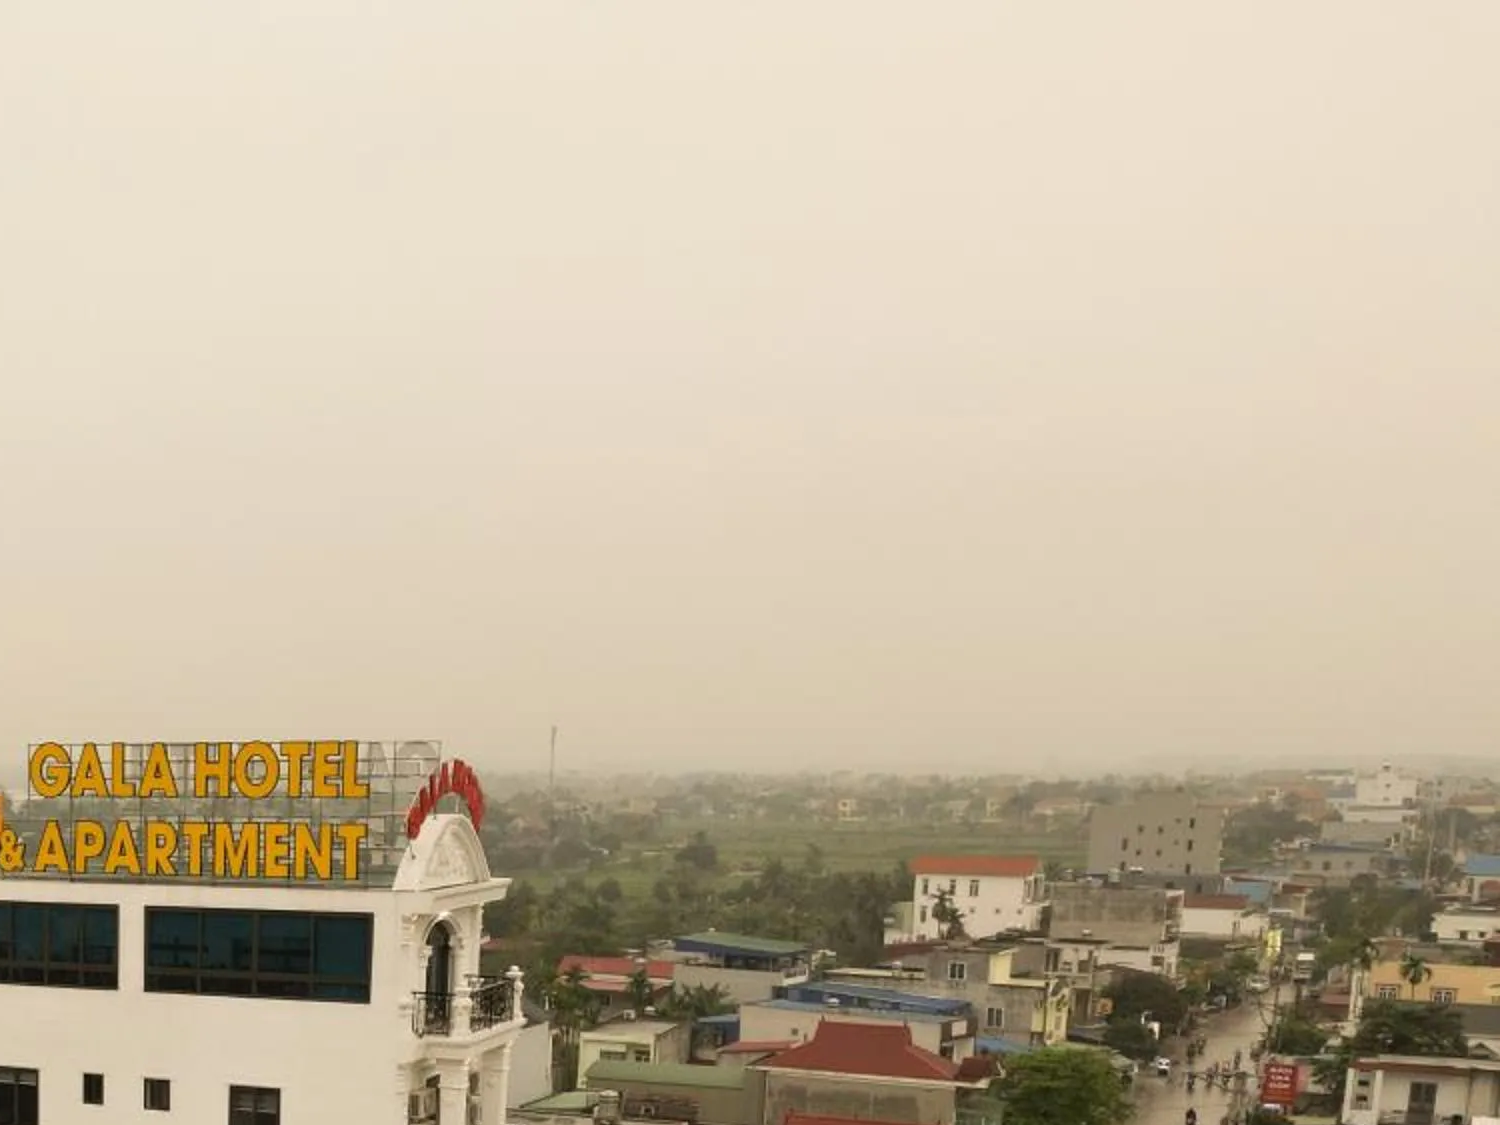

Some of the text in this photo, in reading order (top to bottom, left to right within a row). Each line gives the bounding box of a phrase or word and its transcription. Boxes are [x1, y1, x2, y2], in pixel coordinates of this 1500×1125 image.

[29, 741, 179, 798] GALA
[194, 740, 371, 798] HOTEL
[0, 819, 369, 881] & APARTMENT
